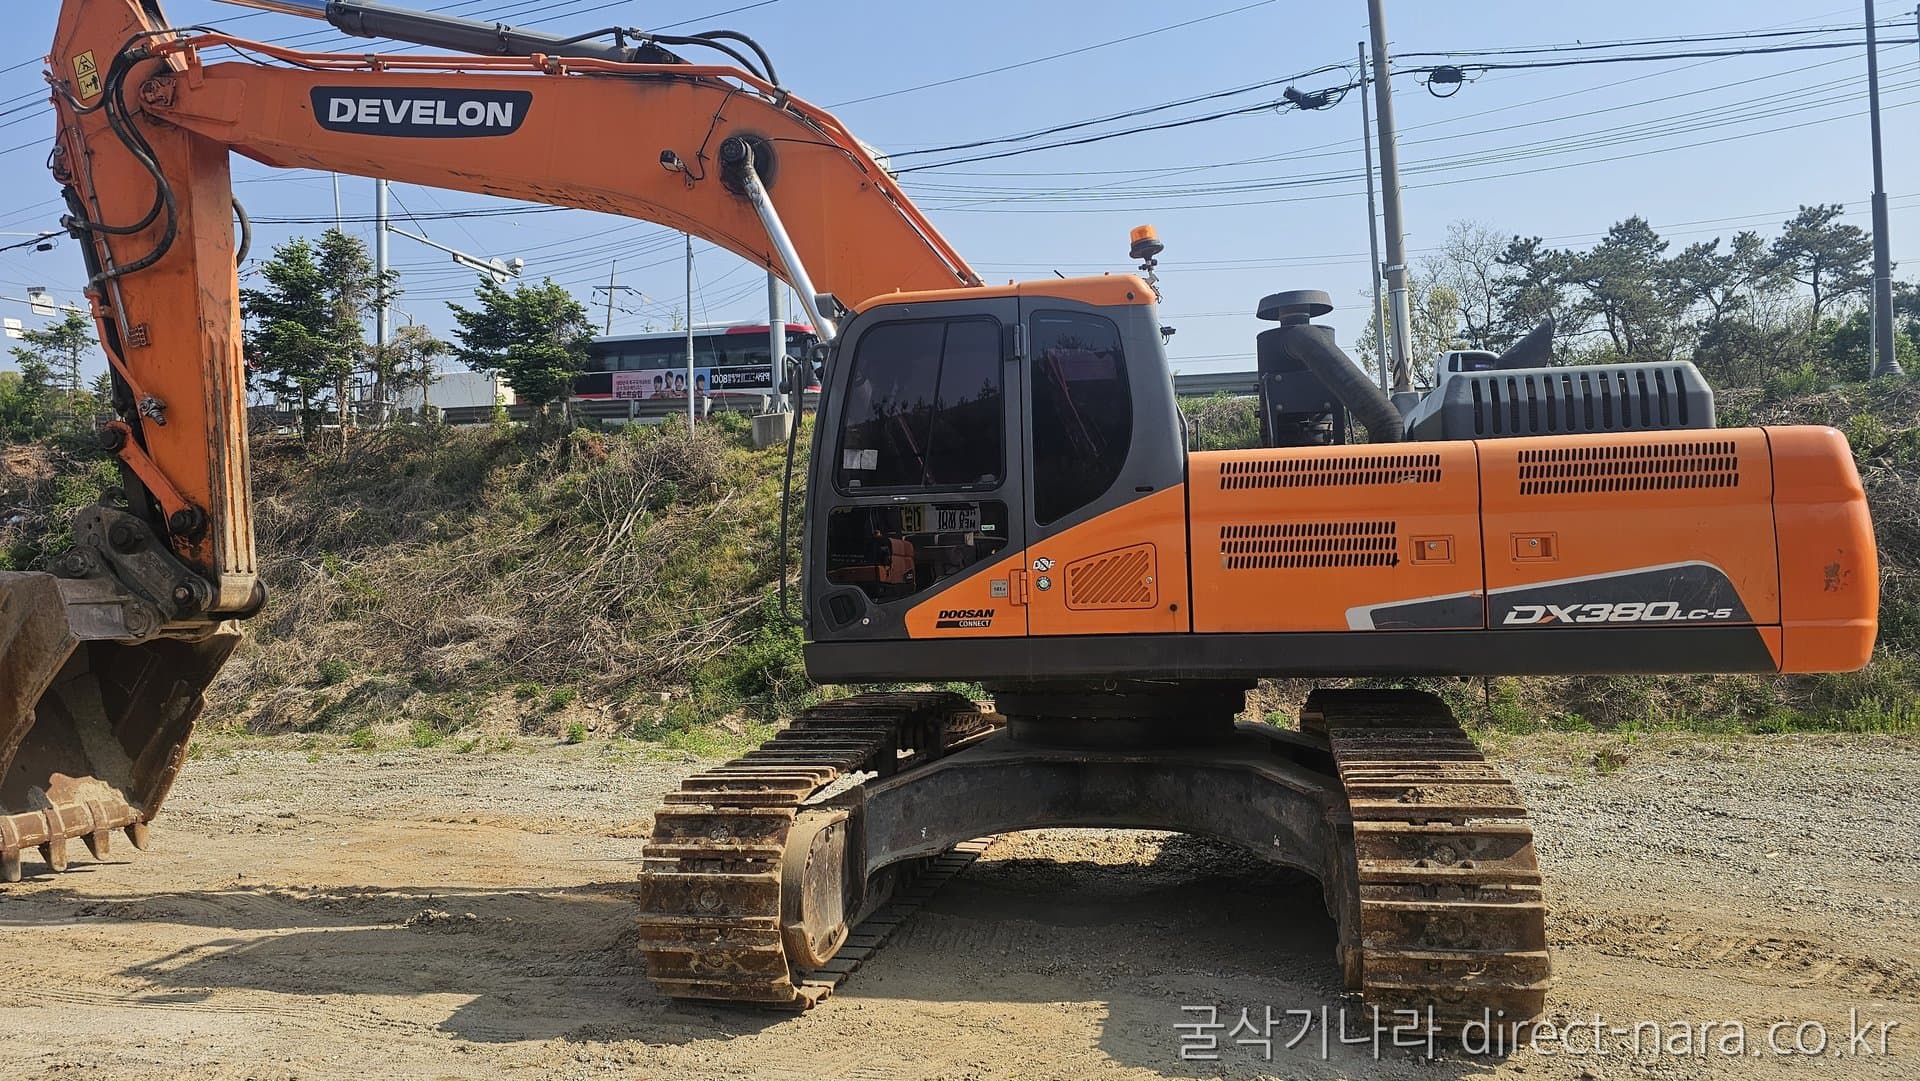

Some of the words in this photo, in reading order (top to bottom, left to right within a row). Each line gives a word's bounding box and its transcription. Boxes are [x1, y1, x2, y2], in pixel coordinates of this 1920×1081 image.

[328, 97, 513, 127] DEVELON
[711, 374, 728, 384] 1008
[938, 609, 995, 619] DOOSAN
[1503, 602, 1733, 625] DX380LC-5
